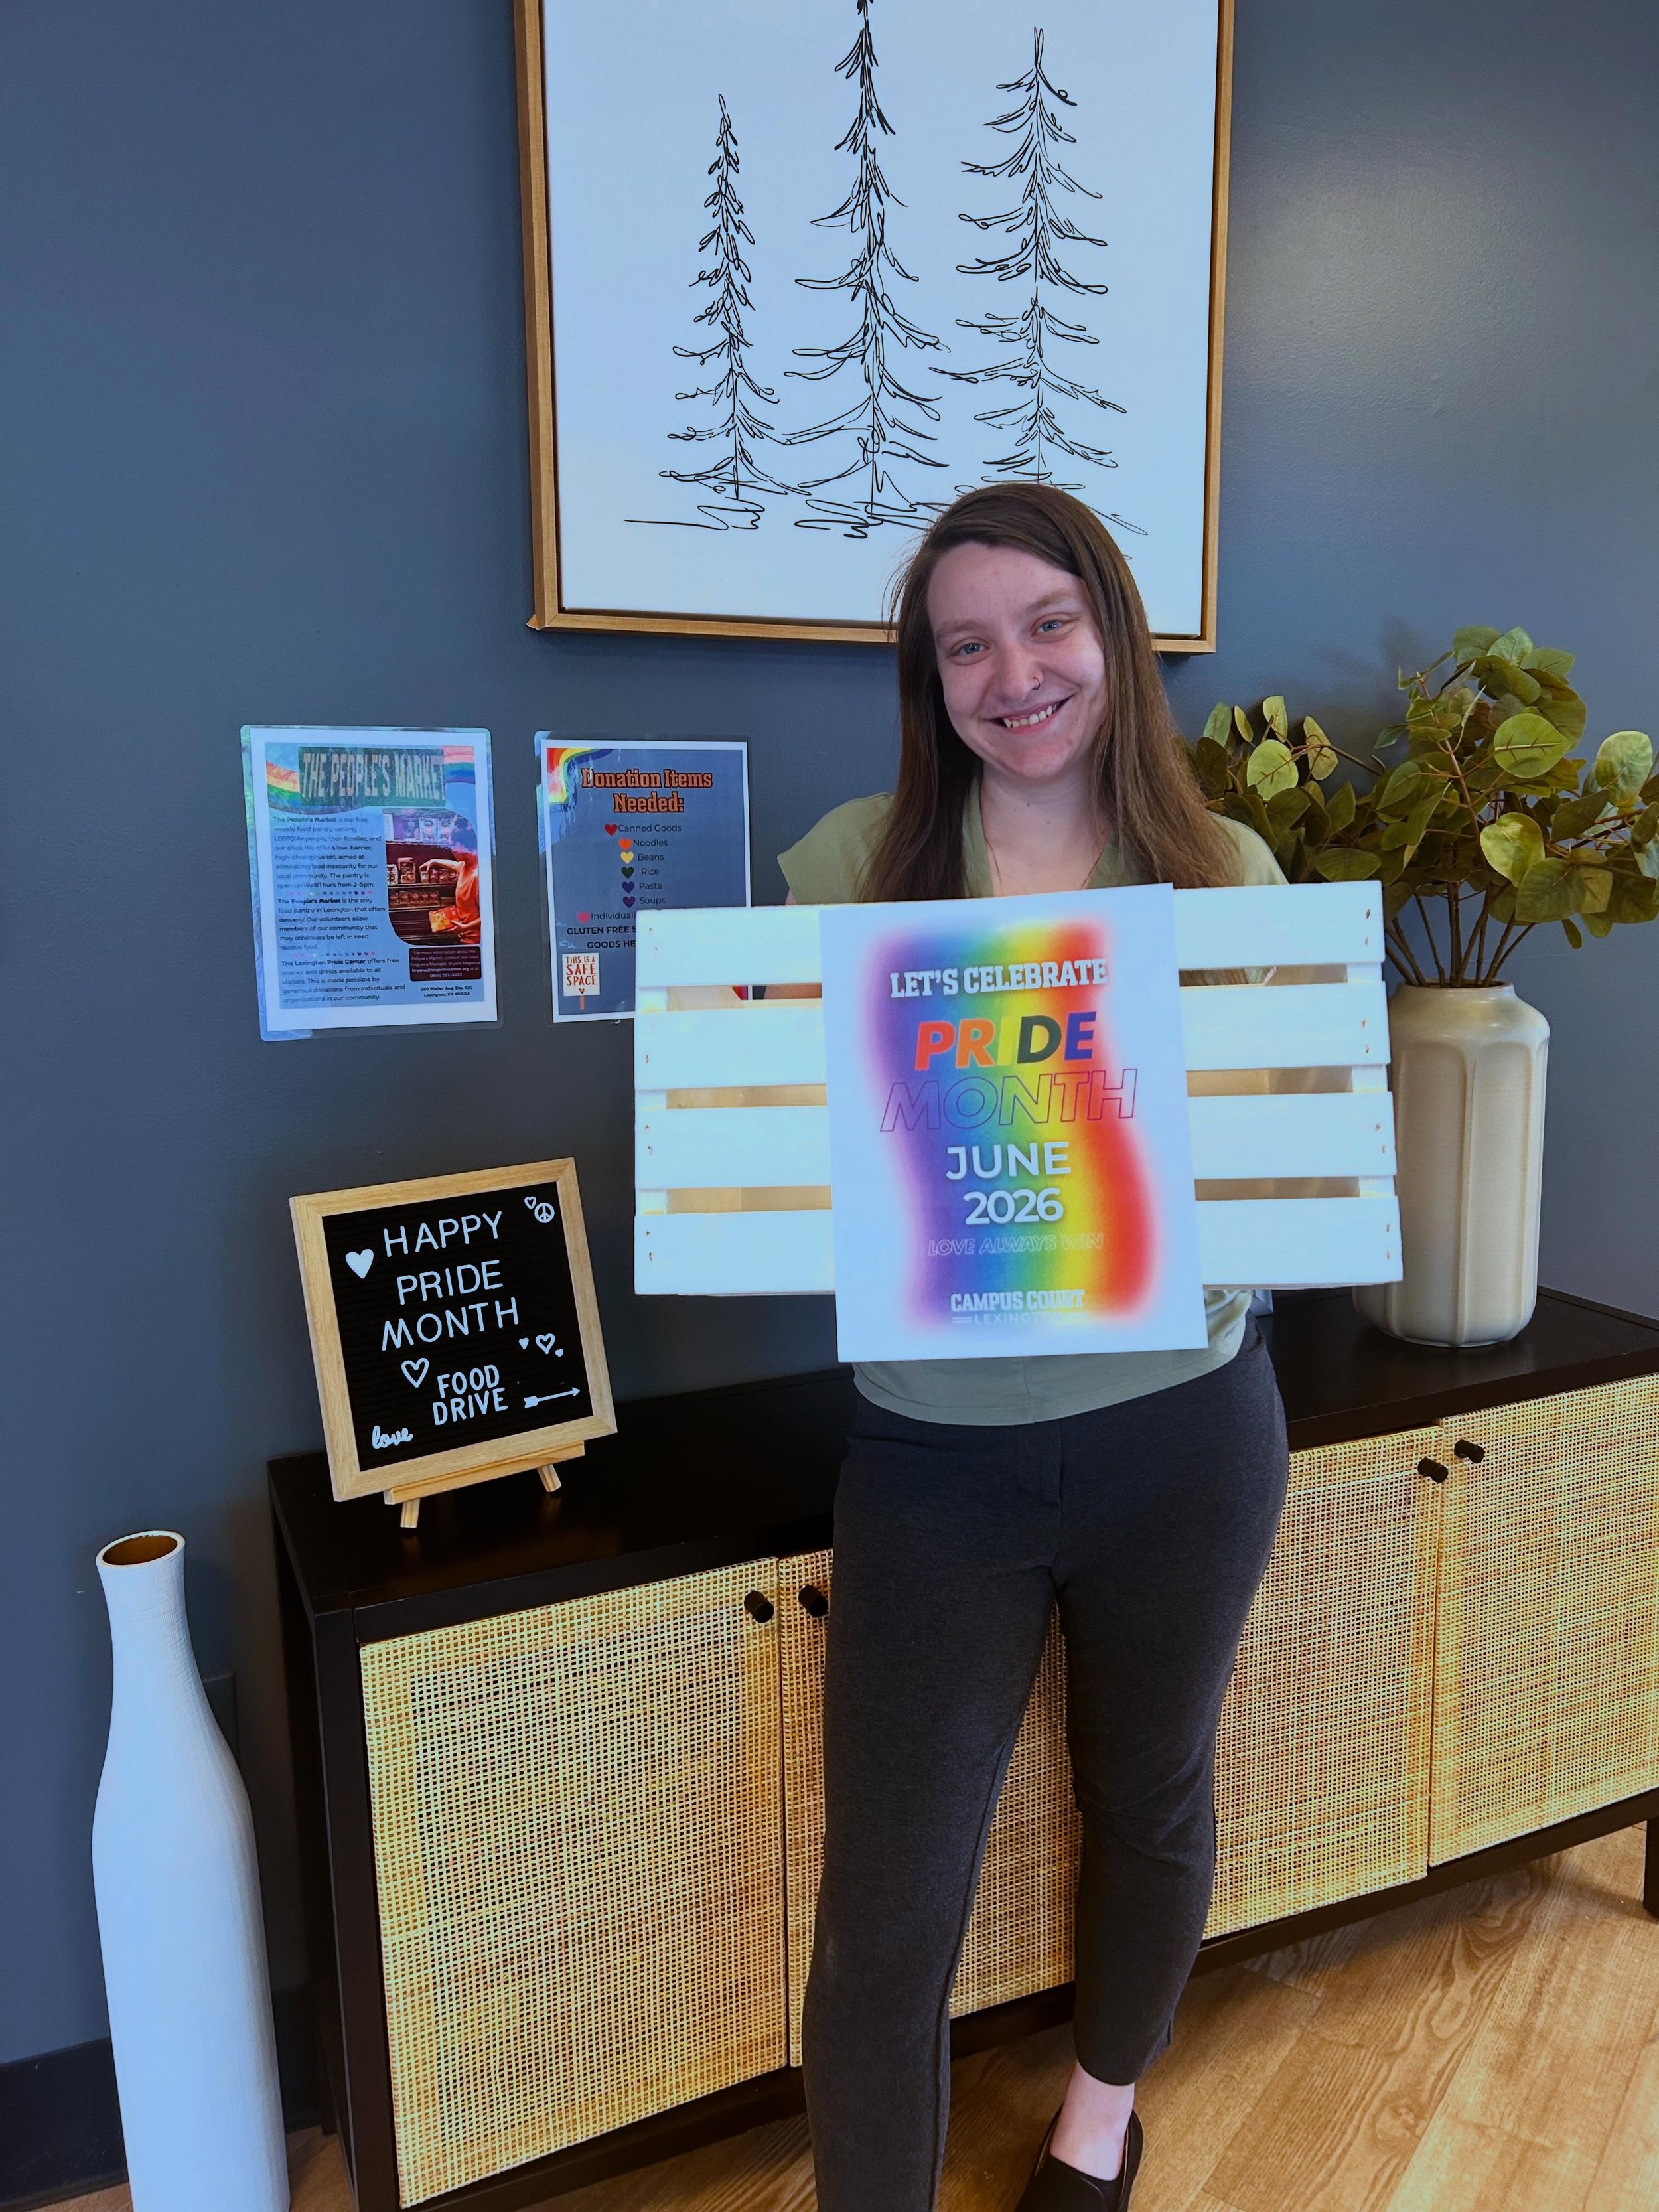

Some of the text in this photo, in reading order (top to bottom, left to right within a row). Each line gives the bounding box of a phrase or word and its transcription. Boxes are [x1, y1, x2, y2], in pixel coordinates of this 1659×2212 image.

[303, 753, 445, 800] THE PEOPLE'S MARKET
[581, 767, 713, 789] Donation Items
[613, 793, 685, 814] Needed:
[618, 823, 682, 832] Canned Goods
[632, 838, 668, 847] Noodles
[638, 853, 664, 861] Beans
[639, 896, 666, 905] Soups
[567, 926, 604, 935] GLUTEN
[566, 963, 597, 976] SAFE
[567, 975, 597, 986] SPACE
[889, 958, 1108, 999] LET'S CELEBRATE
[914, 1011, 1097, 1071] PRIDE
[879, 1068, 1138, 1132] MONTH
[945, 1142, 1072, 1181] JUNE
[964, 1187, 1064, 1226] 2026
[383, 1211, 502, 1257] HAPPY
[928, 1238, 975, 1256] LOVE
[978, 1234, 1057, 1254] ALWAYS
[397, 1260, 503, 1305] PRIDE
[950, 1289, 1085, 1313] CAMPUS COURT
[381, 1297, 519, 1351] MONTH
[437, 1364, 500, 1398] FOOD
[432, 1388, 508, 1426] DRIVE
[372, 1425, 413, 1449] love
